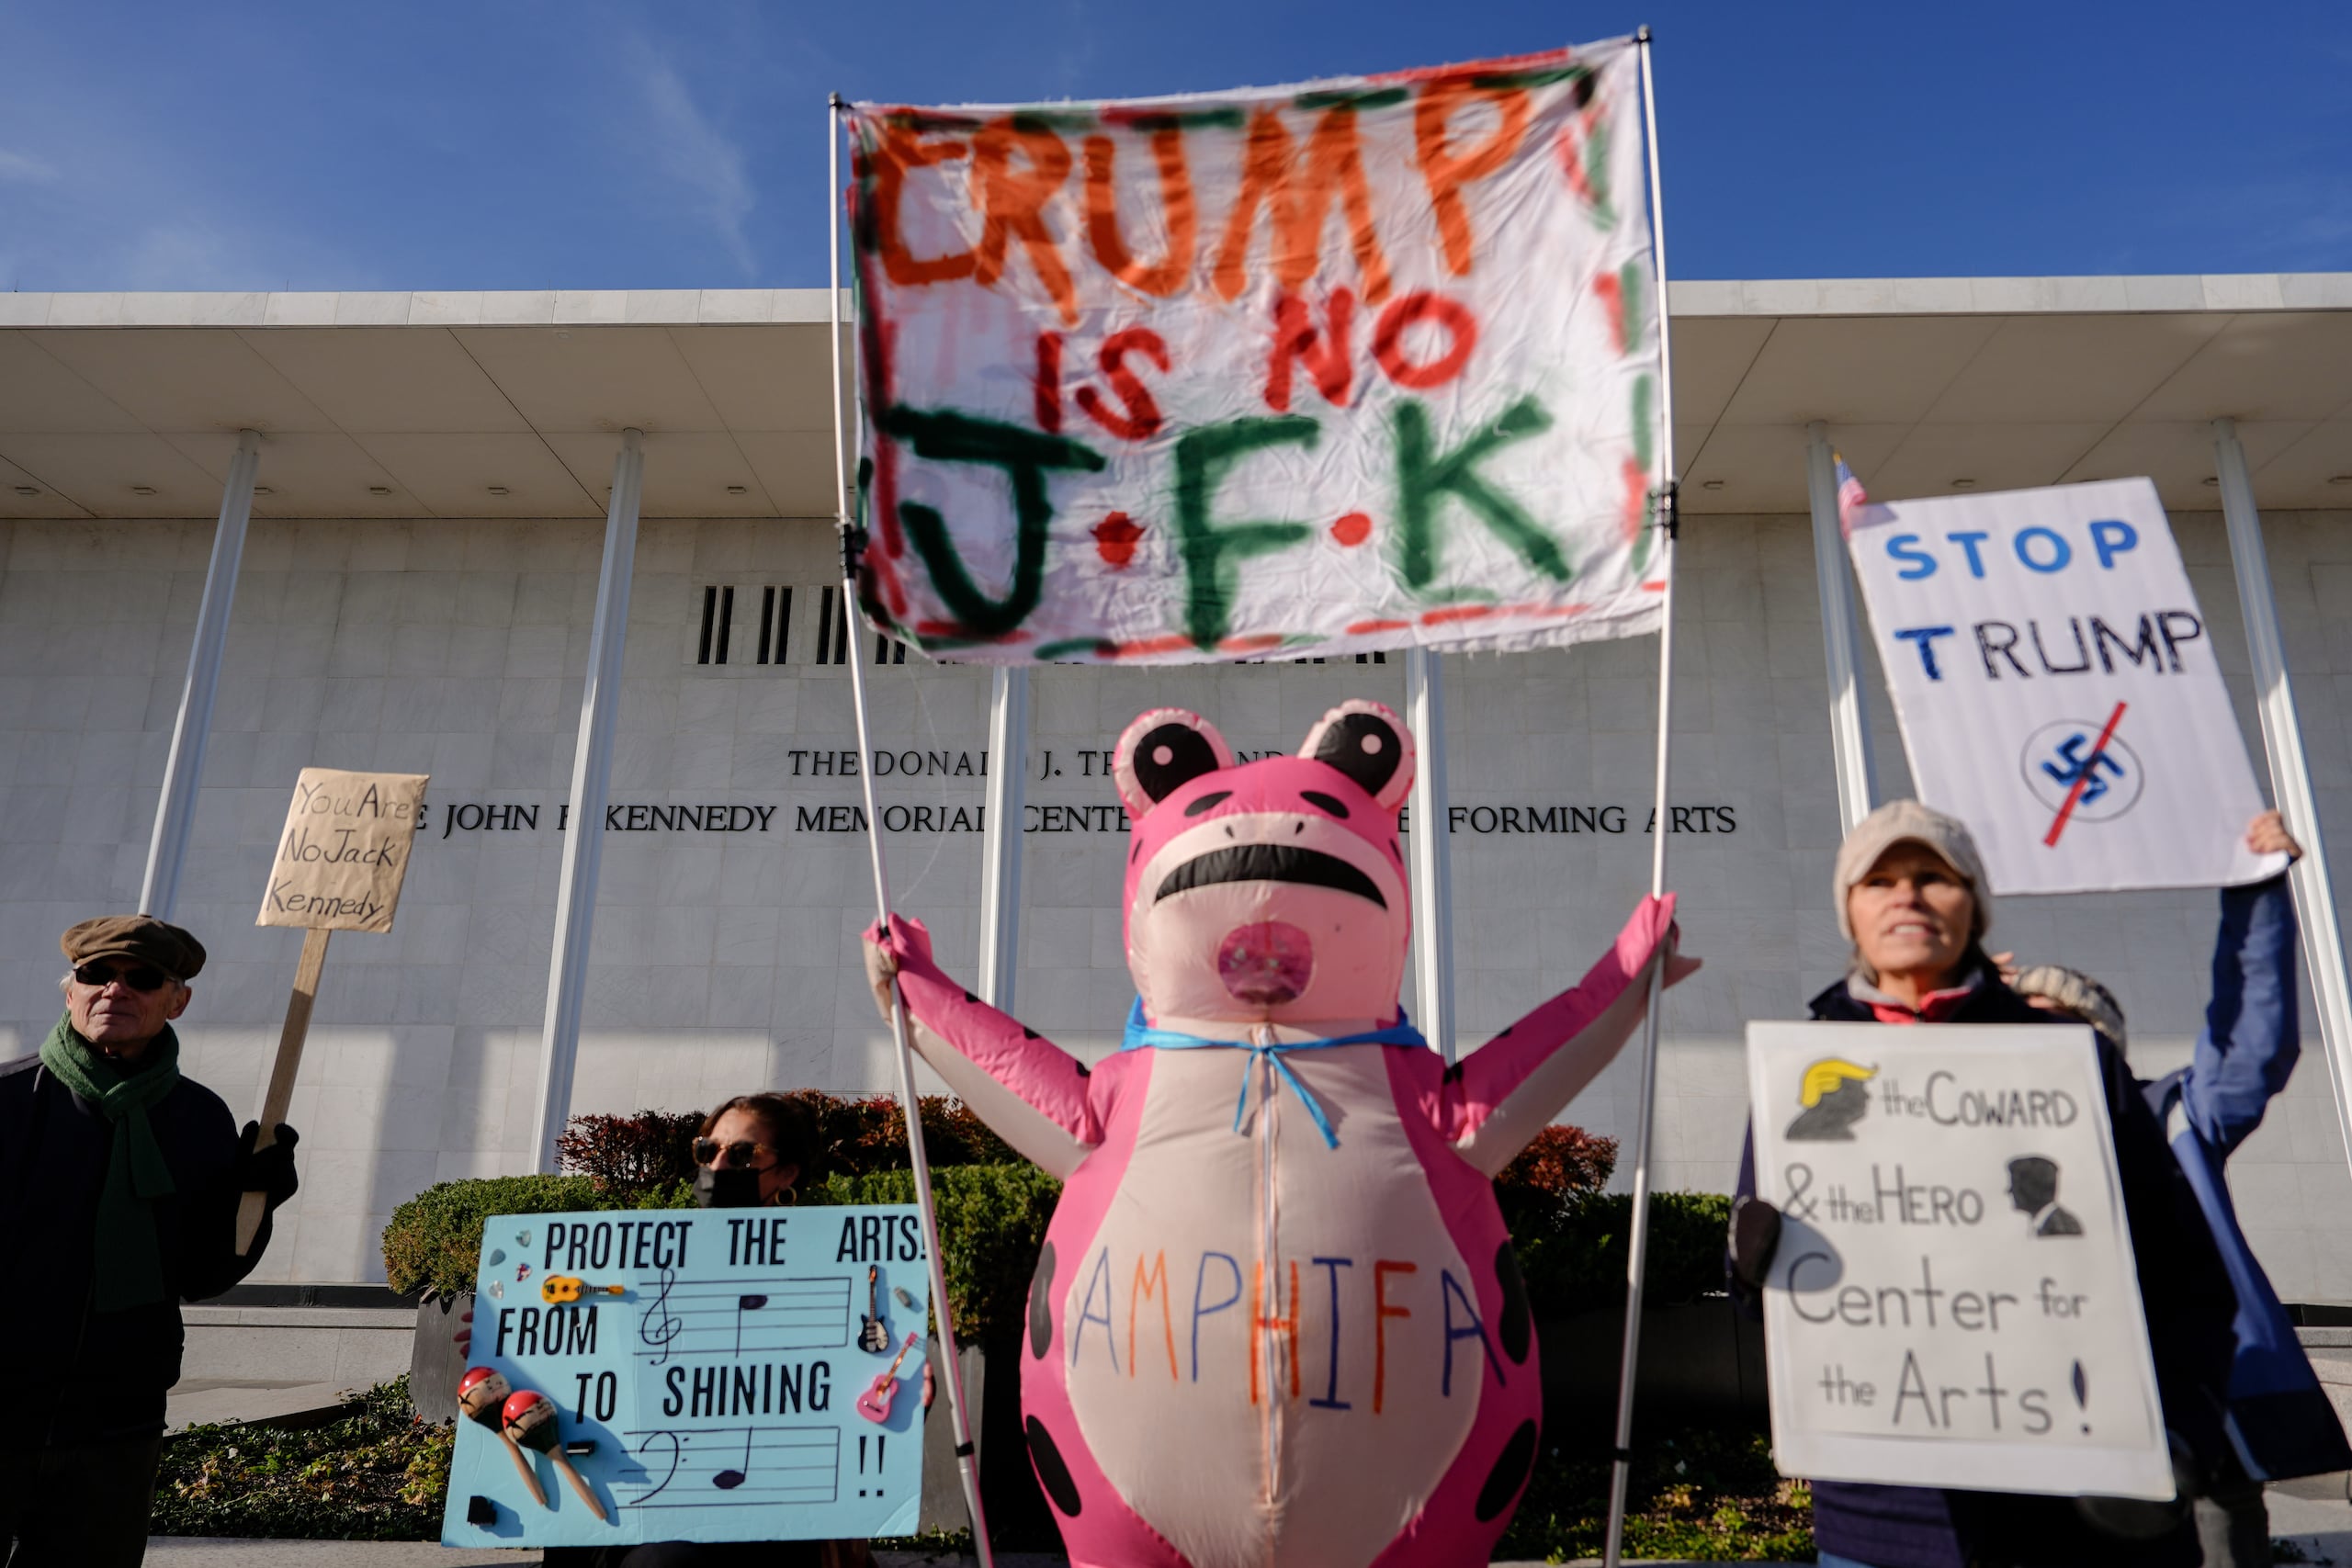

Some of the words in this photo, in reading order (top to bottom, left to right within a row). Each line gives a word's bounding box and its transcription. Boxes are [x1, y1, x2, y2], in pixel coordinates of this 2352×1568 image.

[1035, 326, 1170, 440] IS
[1264, 287, 1481, 413] NO
[1885, 518, 2140, 581] STOP
[1894, 608, 2204, 682] TRUMP
[787, 750, 859, 776] THE
[874, 750, 1028, 776] DONA
[1040, 750, 1061, 781] J.
[300, 783, 352, 817] You
[356, 783, 412, 819] Are
[442, 804, 540, 840] JOHN
[605, 805, 777, 831] KENNEDY
[281, 828, 322, 863] No
[323, 829, 396, 867] Jack
[266, 877, 384, 924] Kennedy
[1880, 1077, 1926, 1119] the
[1781, 1162, 1820, 1224] &
[1825, 1184, 1875, 1225] the
[544, 1221, 693, 1270] PROTECT
[728, 1218, 787, 1267] THE
[1788, 1251, 2018, 1332] Center
[2034, 1276, 2090, 1319] for
[496, 1304, 599, 1358] FROM
[1073, 1246, 1507, 1416] AMPHIFA
[576, 1371, 616, 1424] TO
[662, 1360, 831, 1417] SHINING
[1818, 1364, 1877, 1407] the
